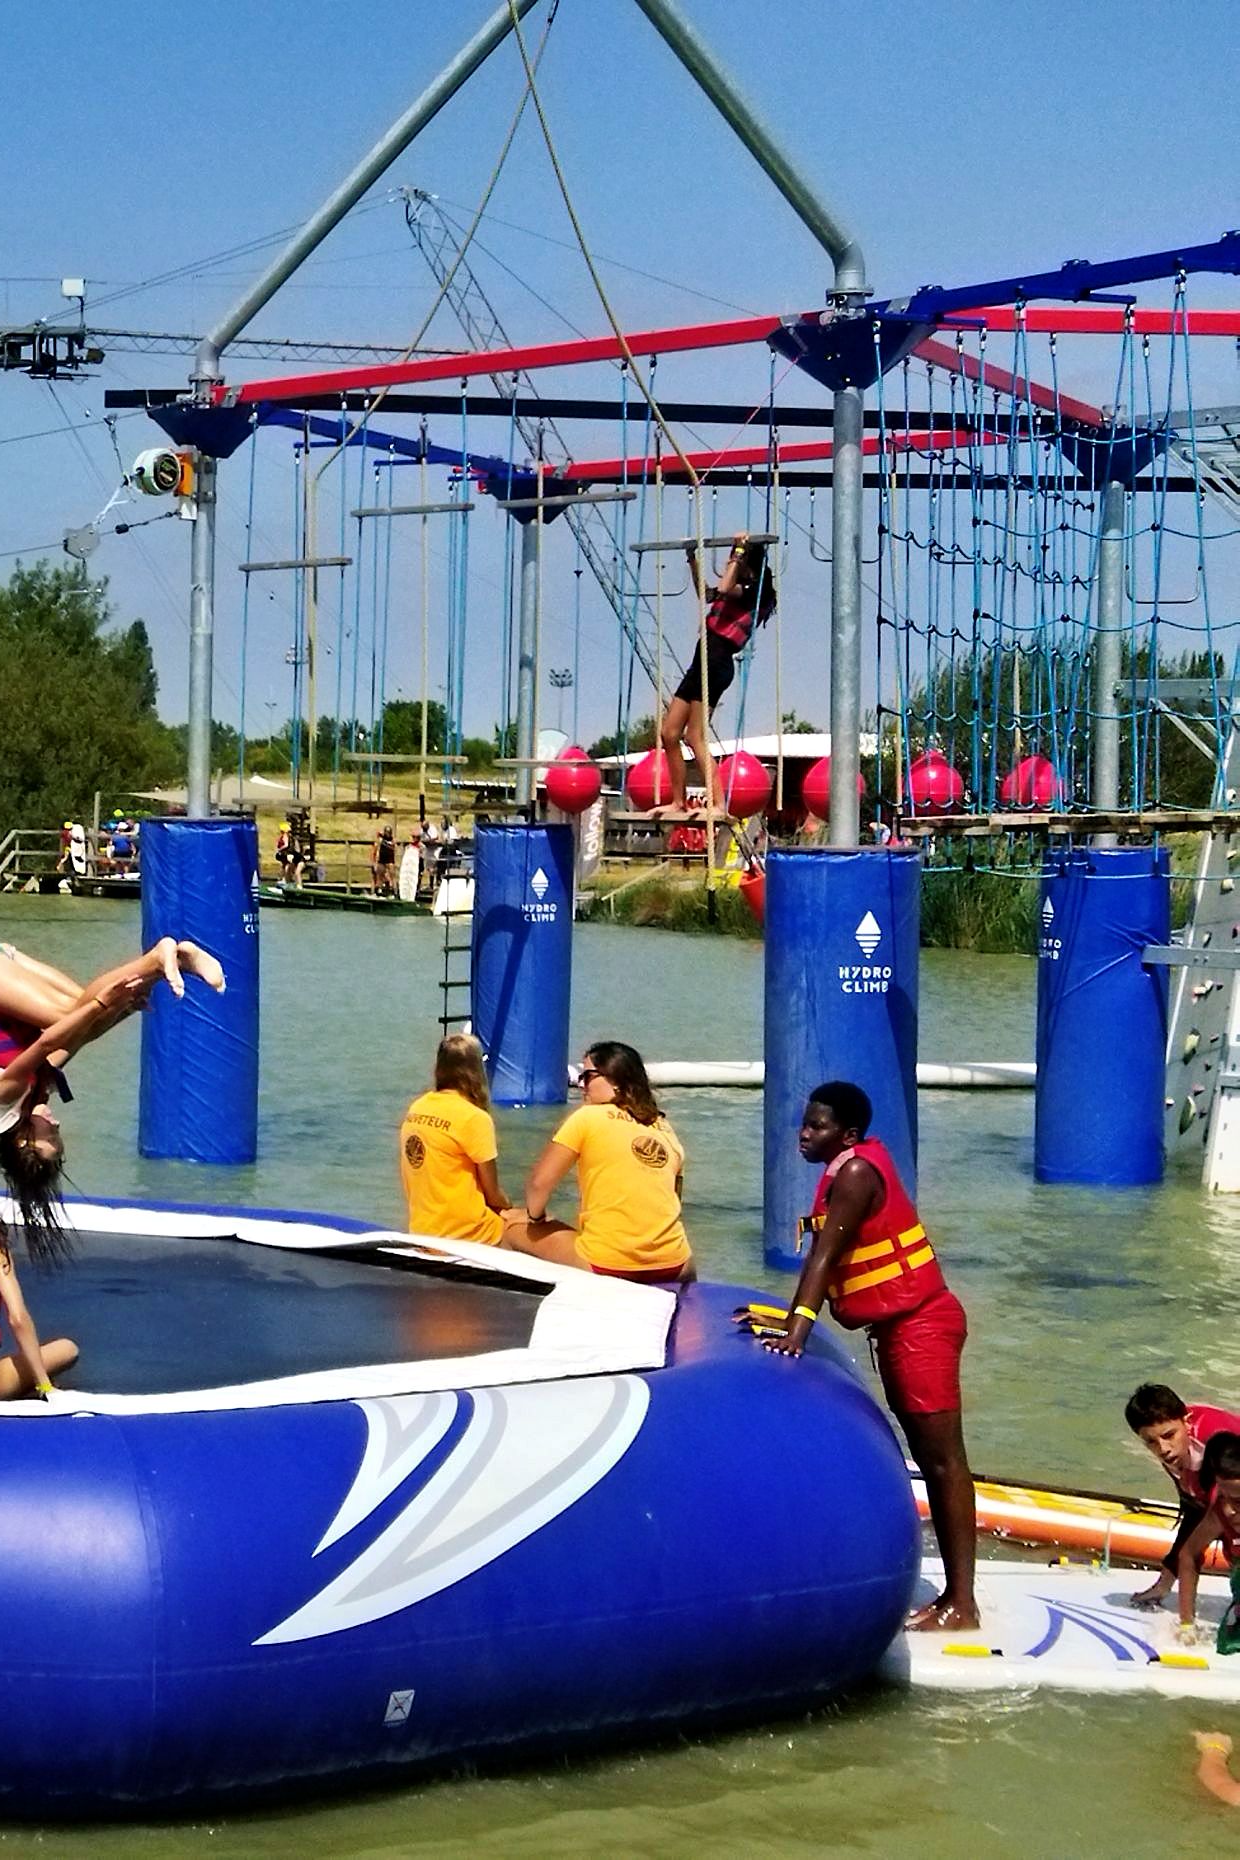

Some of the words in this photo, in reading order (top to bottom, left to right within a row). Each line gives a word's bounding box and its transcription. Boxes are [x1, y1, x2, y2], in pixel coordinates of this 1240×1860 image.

[522, 903, 557, 913] HYDRO
[524, 913, 555, 922] CLIMB
[839, 966, 892, 979] HYDRO
[841, 981, 889, 993] CLIMB
